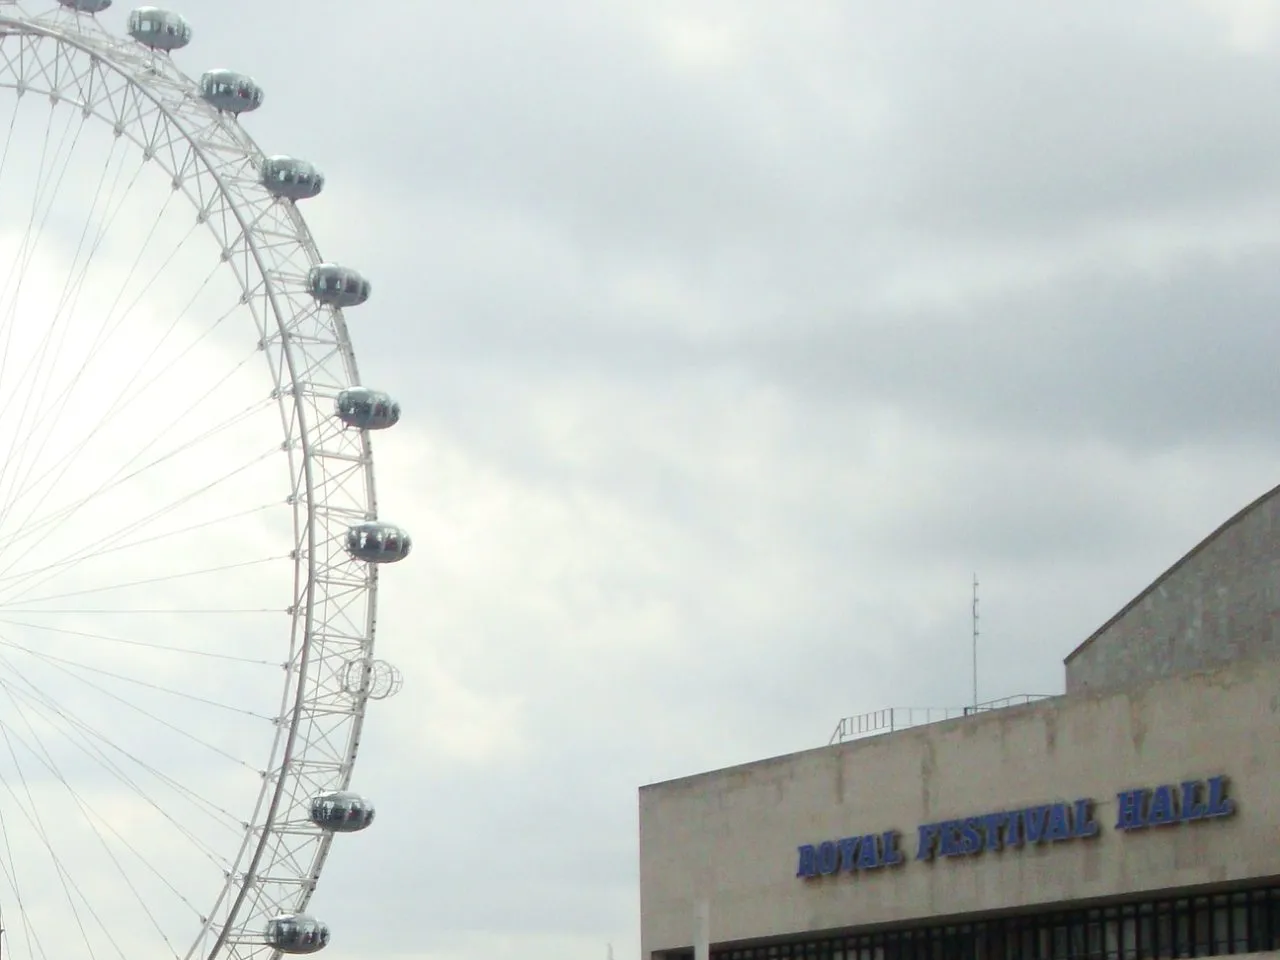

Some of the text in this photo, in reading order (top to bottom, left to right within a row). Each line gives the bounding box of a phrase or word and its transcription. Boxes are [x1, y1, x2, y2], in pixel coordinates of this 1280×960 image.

[797, 774, 1235, 878] ROYAL FESTIVAL HALL
